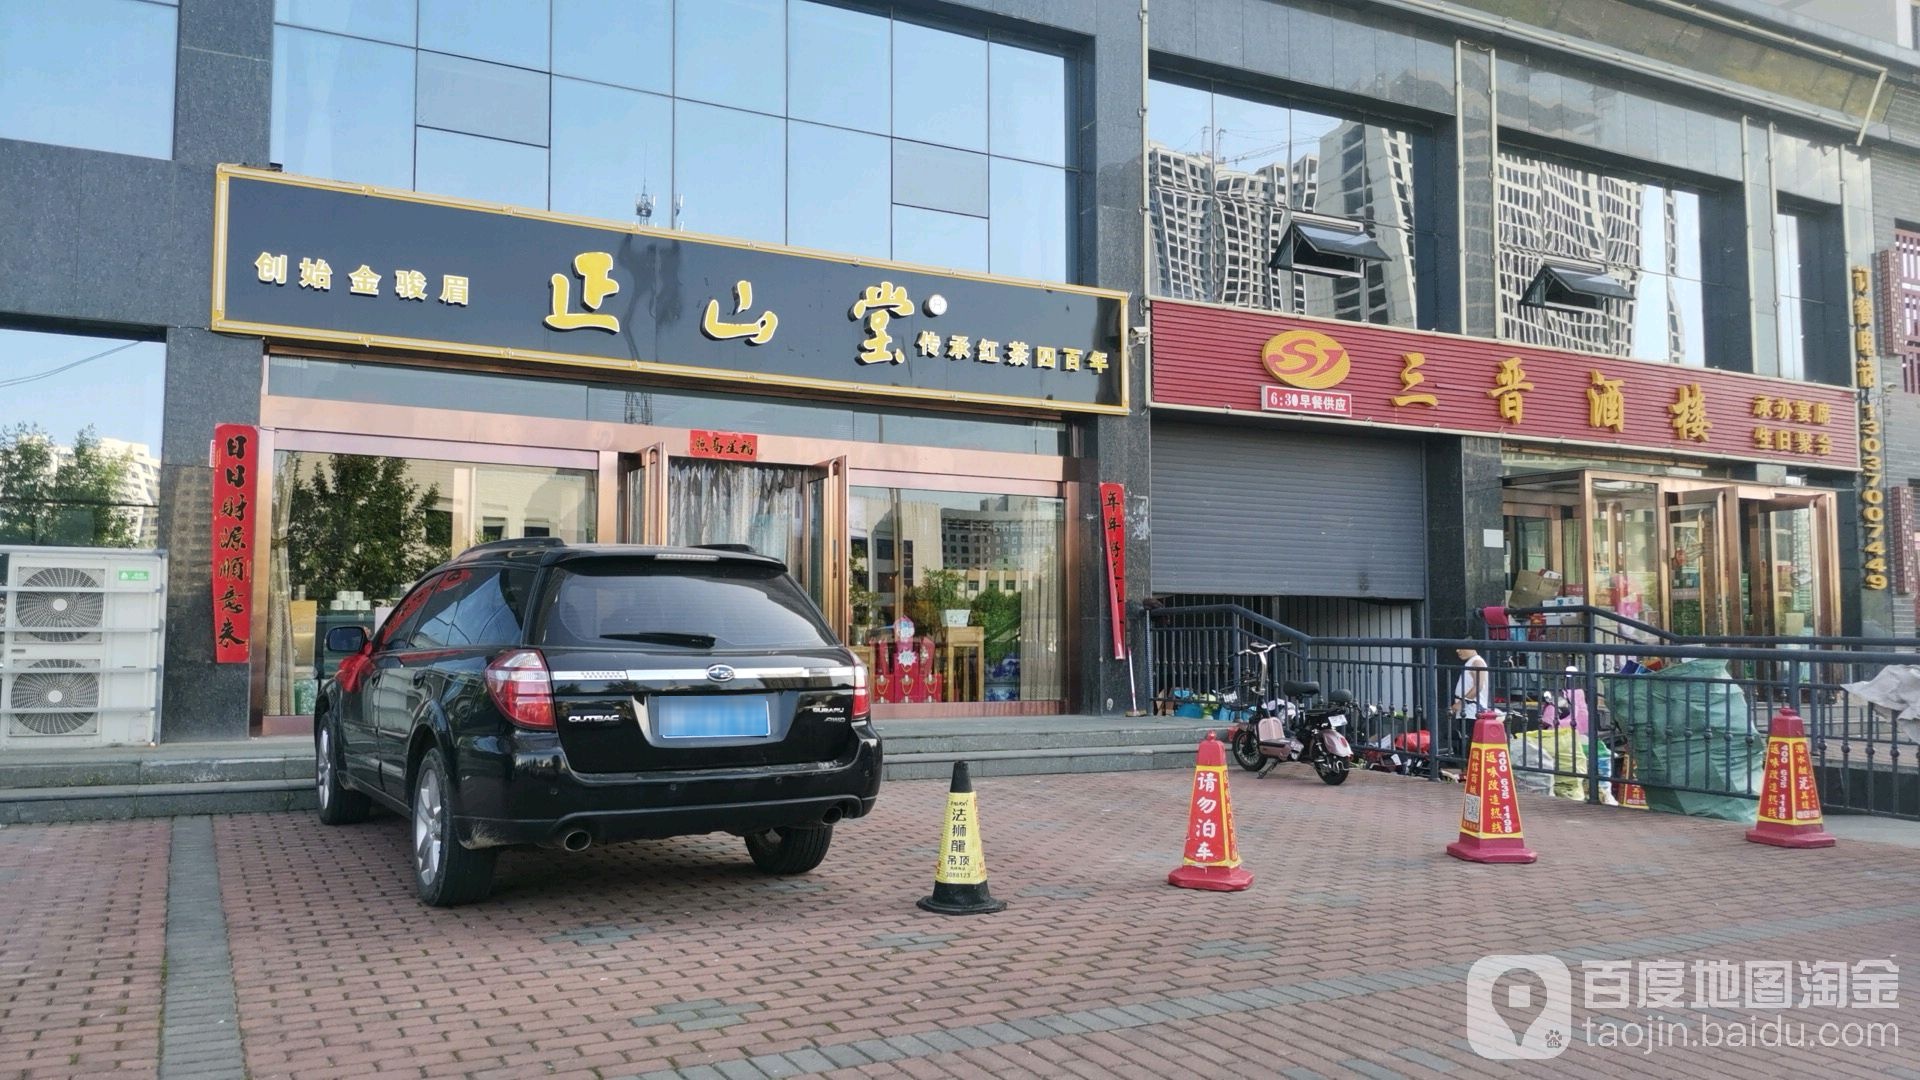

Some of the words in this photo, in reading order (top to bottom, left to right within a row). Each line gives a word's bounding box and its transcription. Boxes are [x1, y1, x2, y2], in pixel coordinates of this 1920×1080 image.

[254, 252, 470, 306] 创始金骏眉
[544, 251, 914, 366] 正山堂
[918, 331, 1110, 375] 传承红茶四百年
[1271, 392, 1347, 412] 6:30早餐供应
[1390, 352, 1713, 443] 三晋酒楼
[1753, 425, 1832, 455] 生日聚会
[1195, 772, 1218, 860] 请勿泊车
[947, 855, 970, 866] 吊顶
